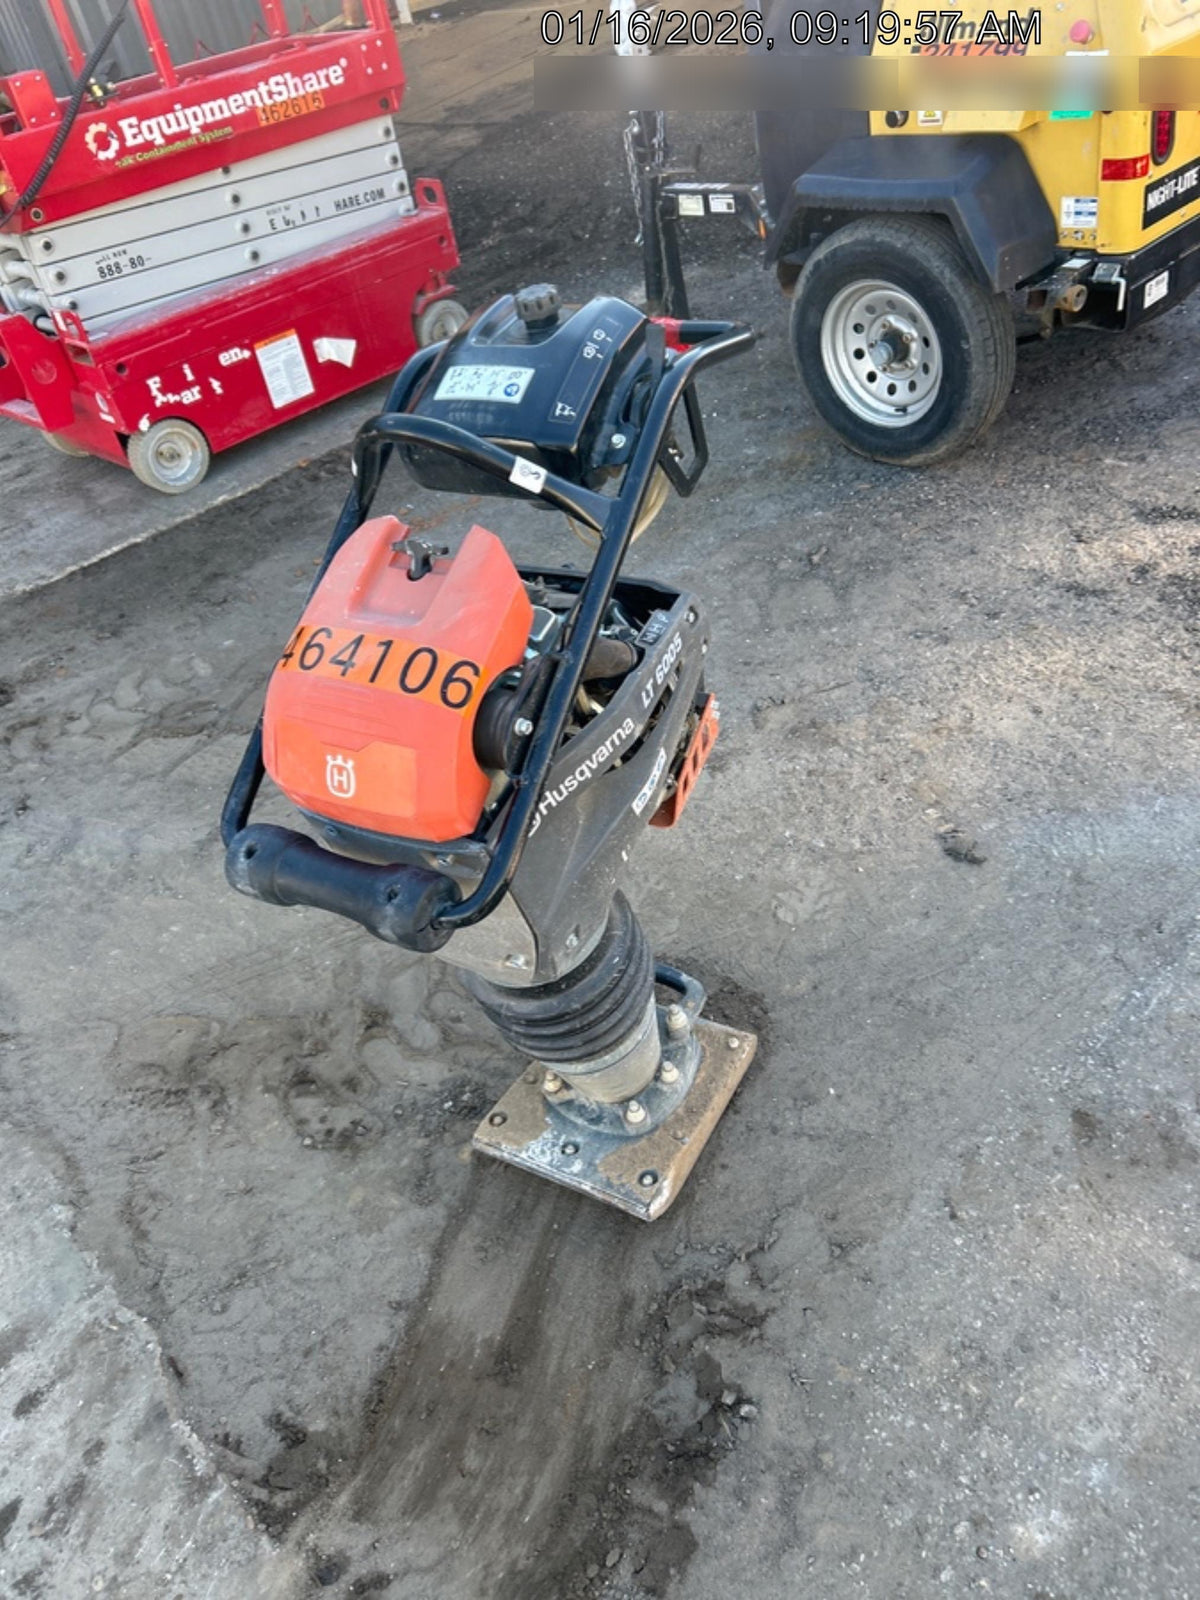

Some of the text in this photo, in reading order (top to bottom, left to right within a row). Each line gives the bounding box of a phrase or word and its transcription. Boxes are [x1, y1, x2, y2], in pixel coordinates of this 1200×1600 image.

[282, 626, 481, 709] 464106
[641, 678, 654, 709] LT
[537, 717, 636, 816] Husqvarna
